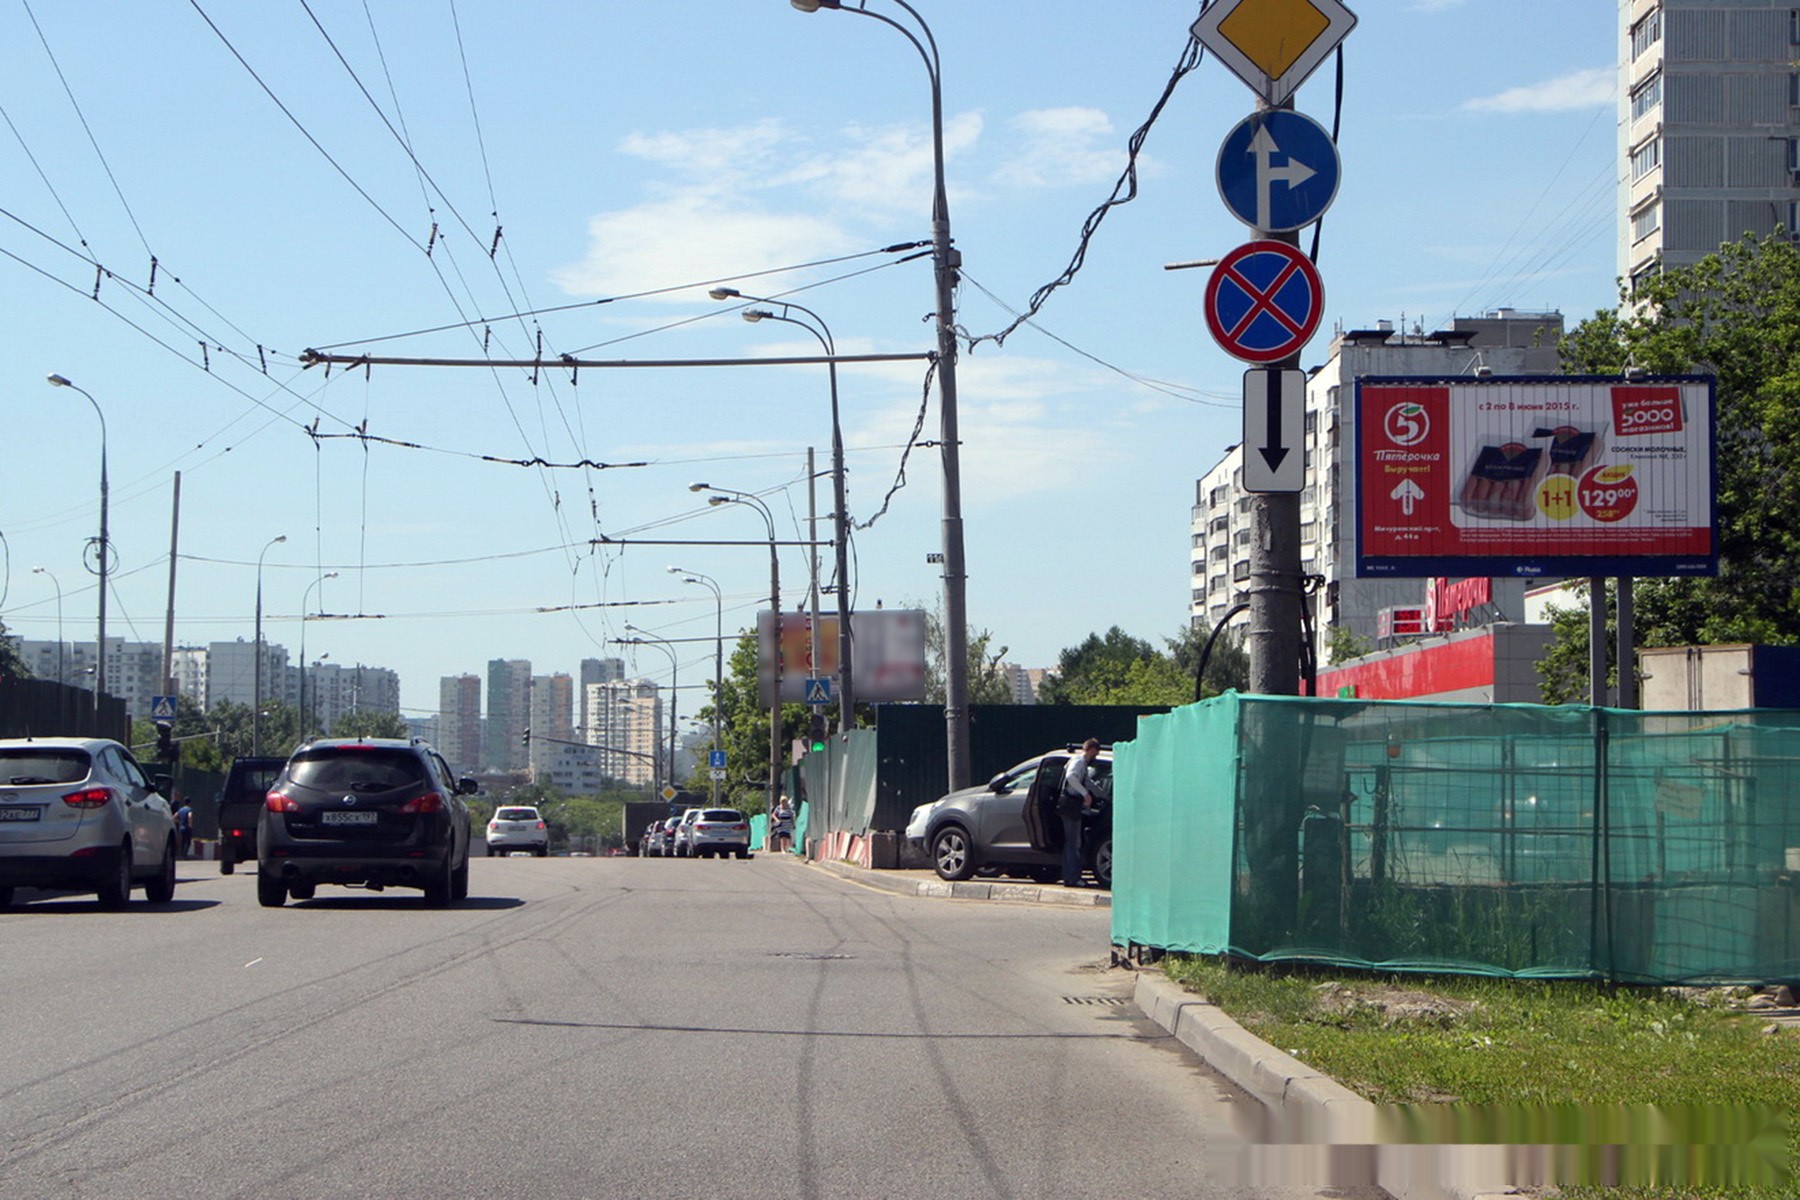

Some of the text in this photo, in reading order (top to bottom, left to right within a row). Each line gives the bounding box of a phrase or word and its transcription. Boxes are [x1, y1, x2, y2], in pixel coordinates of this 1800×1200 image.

[1486, 402, 1492, 410] 2
[1509, 402, 1515, 410] 8
[1546, 402, 1570, 410] 2015
[1621, 408, 1674, 426] 5000
[1394, 415, 1419, 443] 5
[1542, 490, 1571, 507] 1+1
